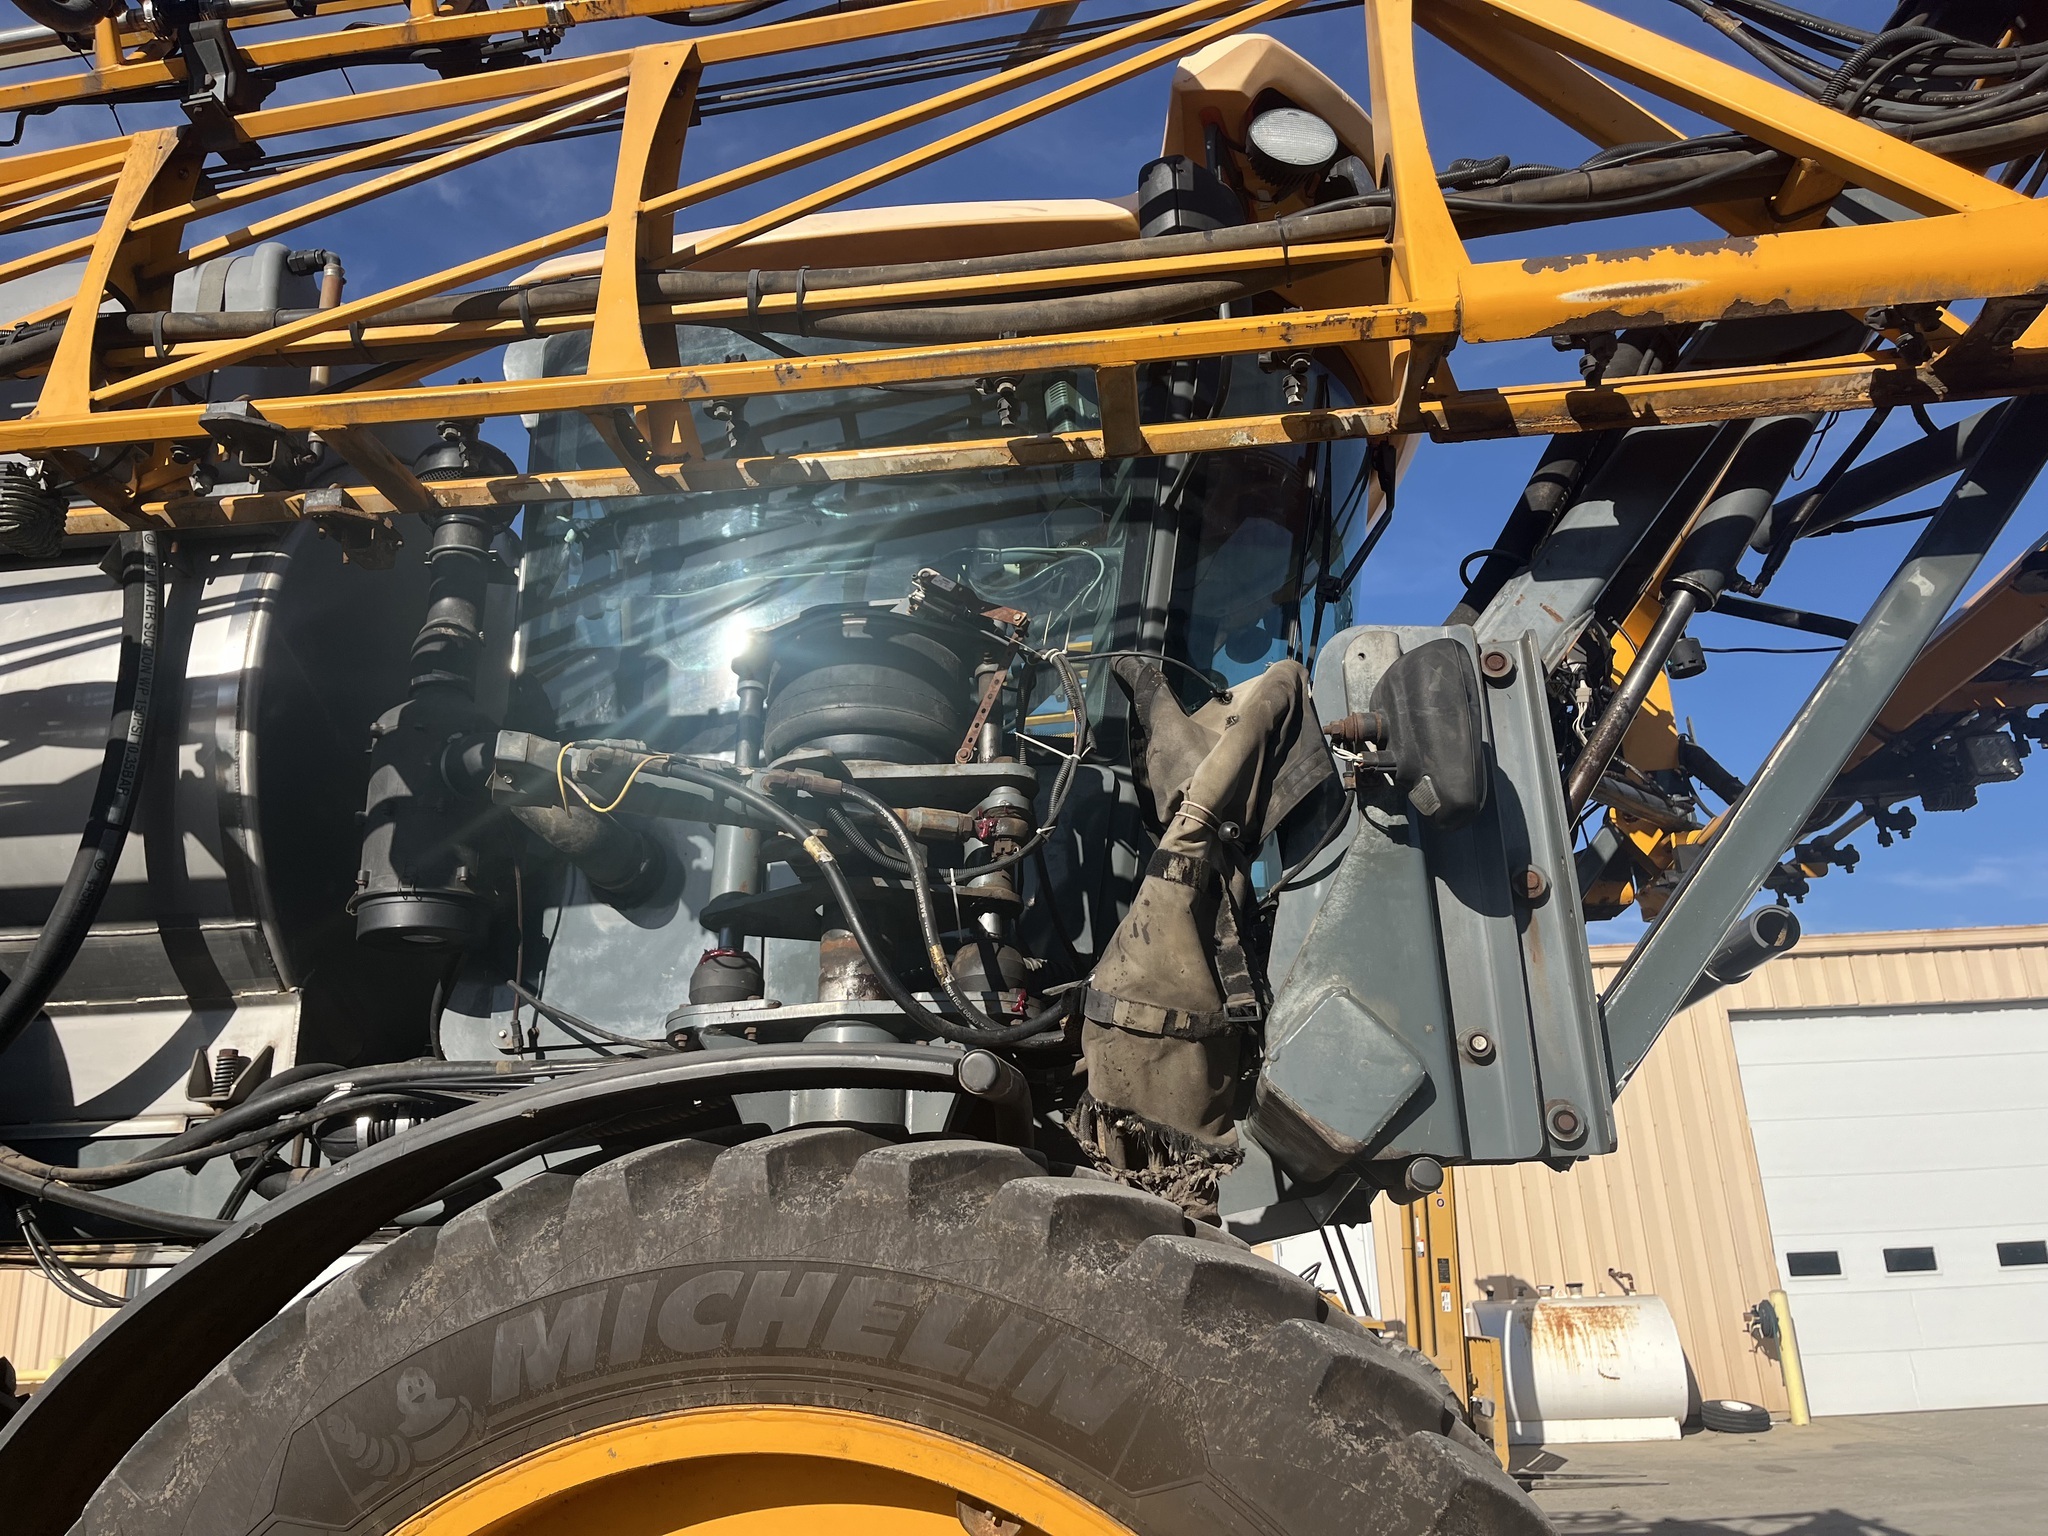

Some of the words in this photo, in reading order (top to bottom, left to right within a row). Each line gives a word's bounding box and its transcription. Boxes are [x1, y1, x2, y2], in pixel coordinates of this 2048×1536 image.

[145, 580, 157, 620] WATER
[140, 622, 156, 676] SUCTION
[138, 677, 152, 695] WP
[131, 699, 147, 737] 150PSI
[490, 1270, 1143, 1438] MICHELIN
